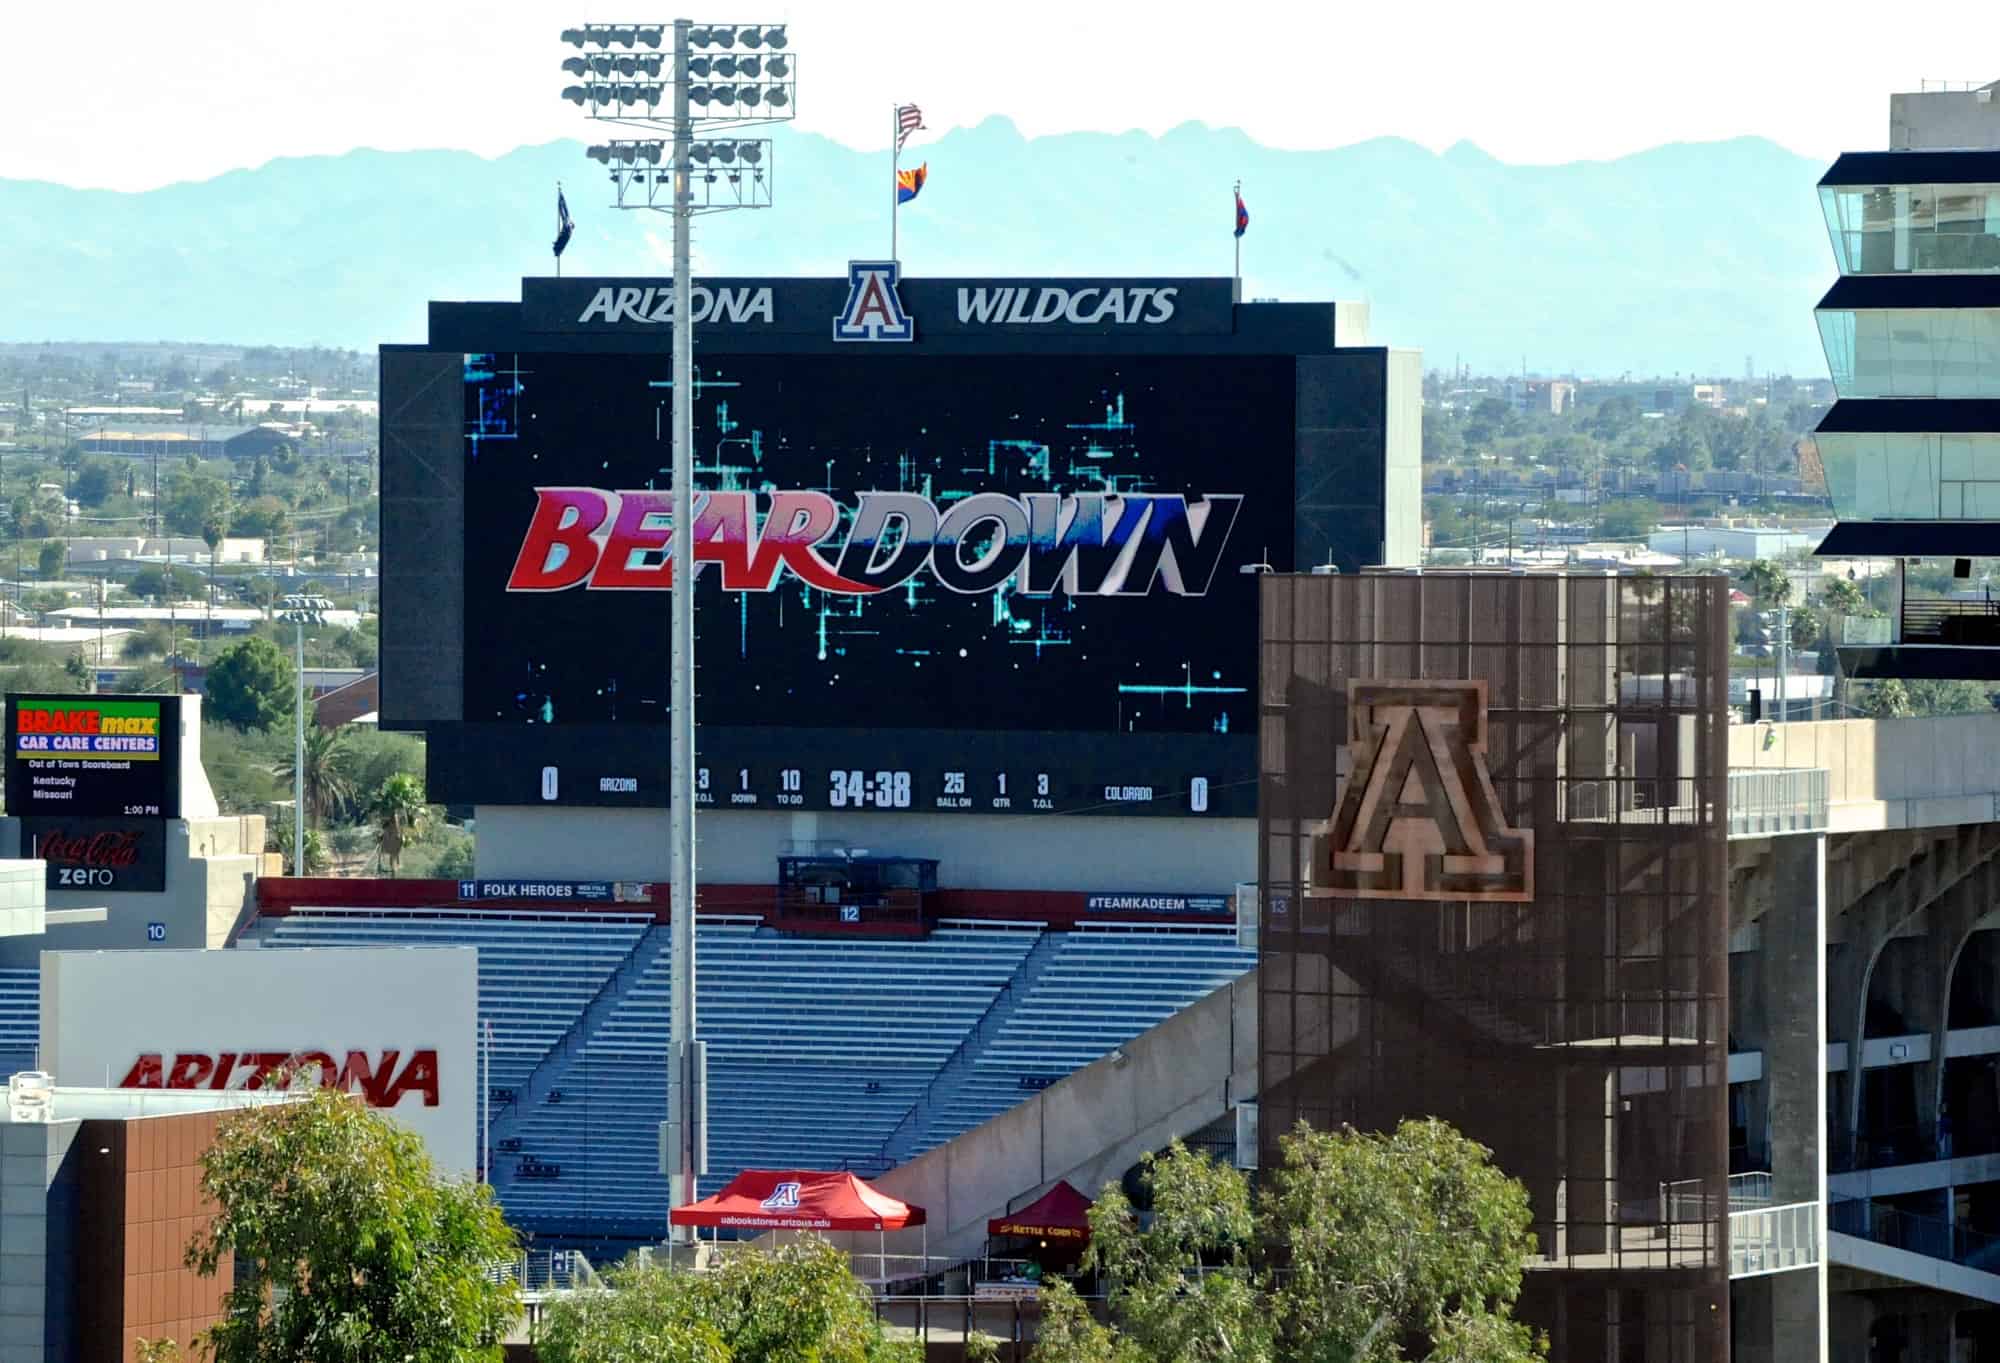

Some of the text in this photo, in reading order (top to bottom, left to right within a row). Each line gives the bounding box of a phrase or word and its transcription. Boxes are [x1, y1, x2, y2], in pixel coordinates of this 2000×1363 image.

[578, 287, 774, 323] ARIZONA
[956, 287, 1177, 324] WILDCATS
[20, 735, 155, 751] CAR CARE CENTERS
[28, 760, 45, 769] Out
[46, 760, 56, 769] of
[82, 760, 131, 770] Scoreboard
[33, 776, 77, 786] Kentucky
[542, 766, 558, 800] 0
[600, 778, 637, 792] ARIZONA
[698, 768, 709, 789] 3
[740, 769, 748, 790] 1
[781, 769, 800, 791] 10
[944, 772, 965, 794] 25
[997, 773, 1006, 795] 1
[1037, 773, 1049, 796] 3
[33, 790, 73, 799] Missouri
[829, 770, 911, 807] 34:38
[1105, 786, 1152, 801] COLORADO
[1191, 777, 1208, 812] 0
[731, 793, 757, 803] DOWN
[776, 794, 803, 804] TO GO
[936, 797, 972, 808] BALL ON
[992, 798, 1010, 808] QTR
[124, 806, 159, 815] 1:00 PM
[59, 867, 114, 885] zero
[461, 884, 475, 897] 11
[483, 884, 517, 897] FOLK
[520, 884, 573, 897] HEROES
[1089, 897, 1185, 910] #TEAMKADEEM
[1271, 900, 1288, 913] 13
[842, 907, 858, 920] 12
[148, 925, 165, 939] 10
